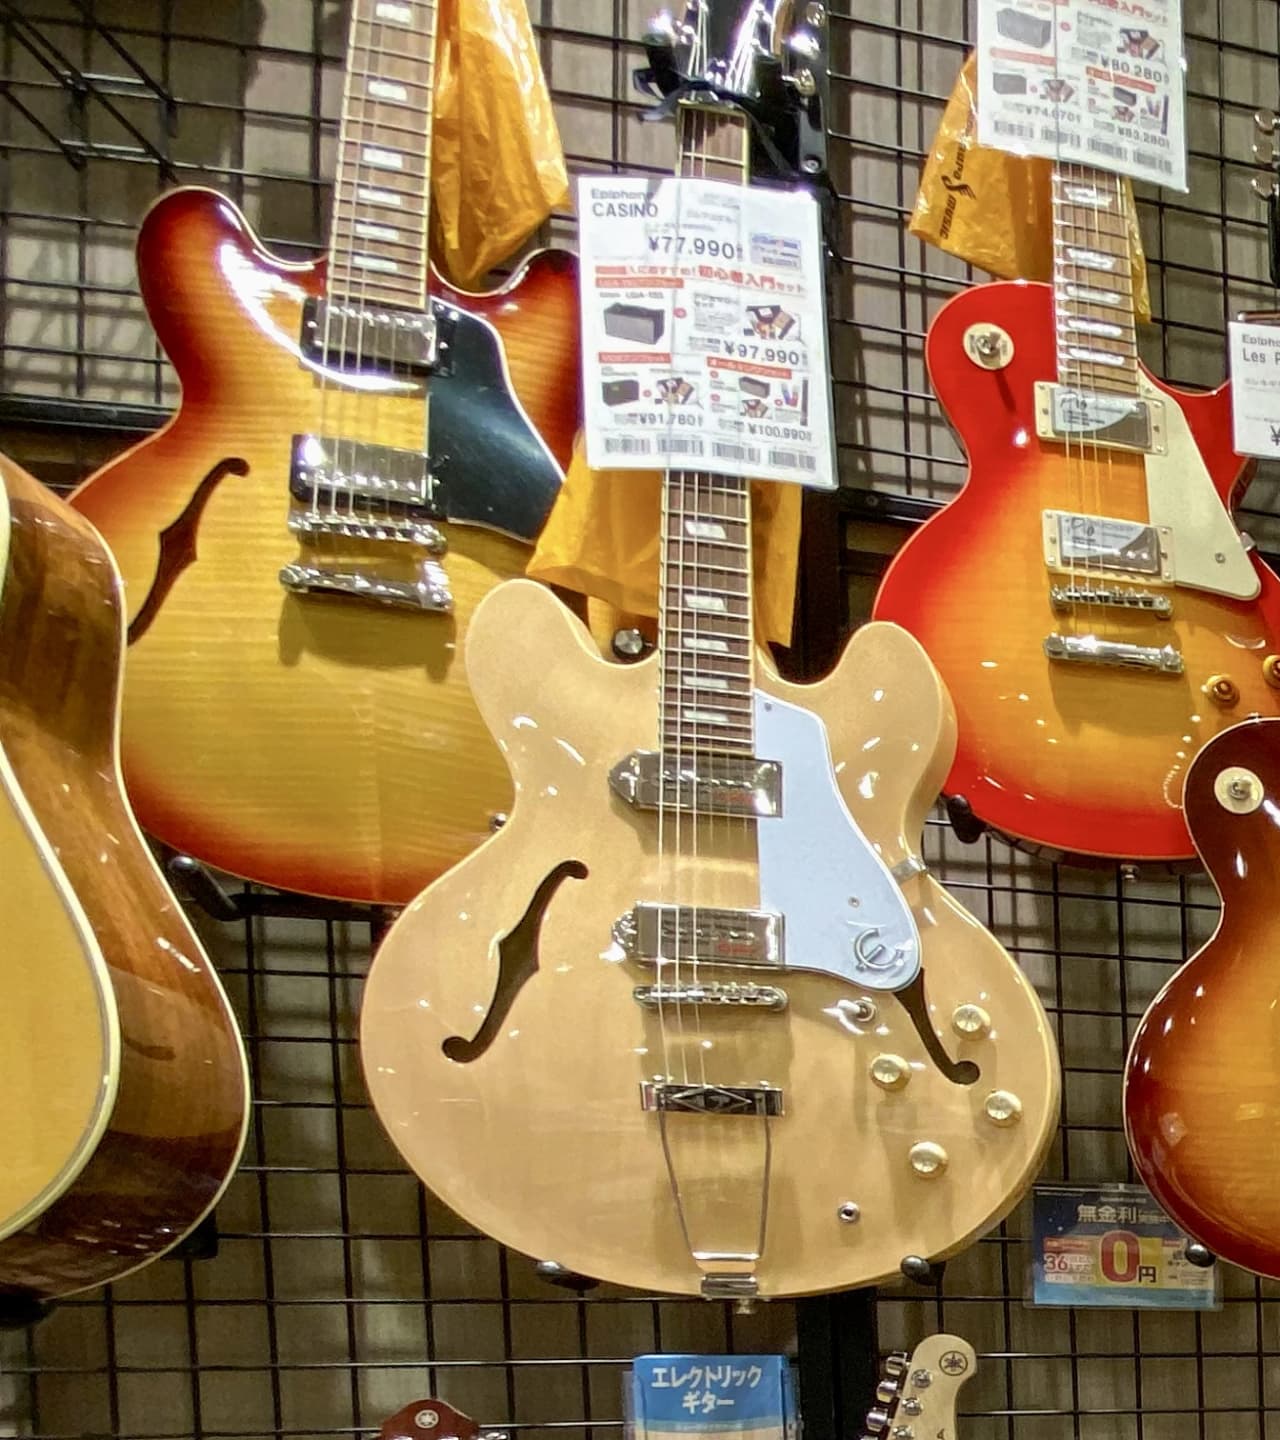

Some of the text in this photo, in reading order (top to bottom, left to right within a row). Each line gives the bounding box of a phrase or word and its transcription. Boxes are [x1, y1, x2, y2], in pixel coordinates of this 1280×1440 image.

[592, 202, 659, 218] CASINO
[1242, 348, 1266, 364] Les
[1078, 1204, 1137, 1224] 無金利
[1044, 1255, 1068, 1272] 36
[1100, 1230, 1157, 1284] 0円
[651, 1365, 762, 1388] エレクトリック
[682, 1391, 735, 1414] ギター
